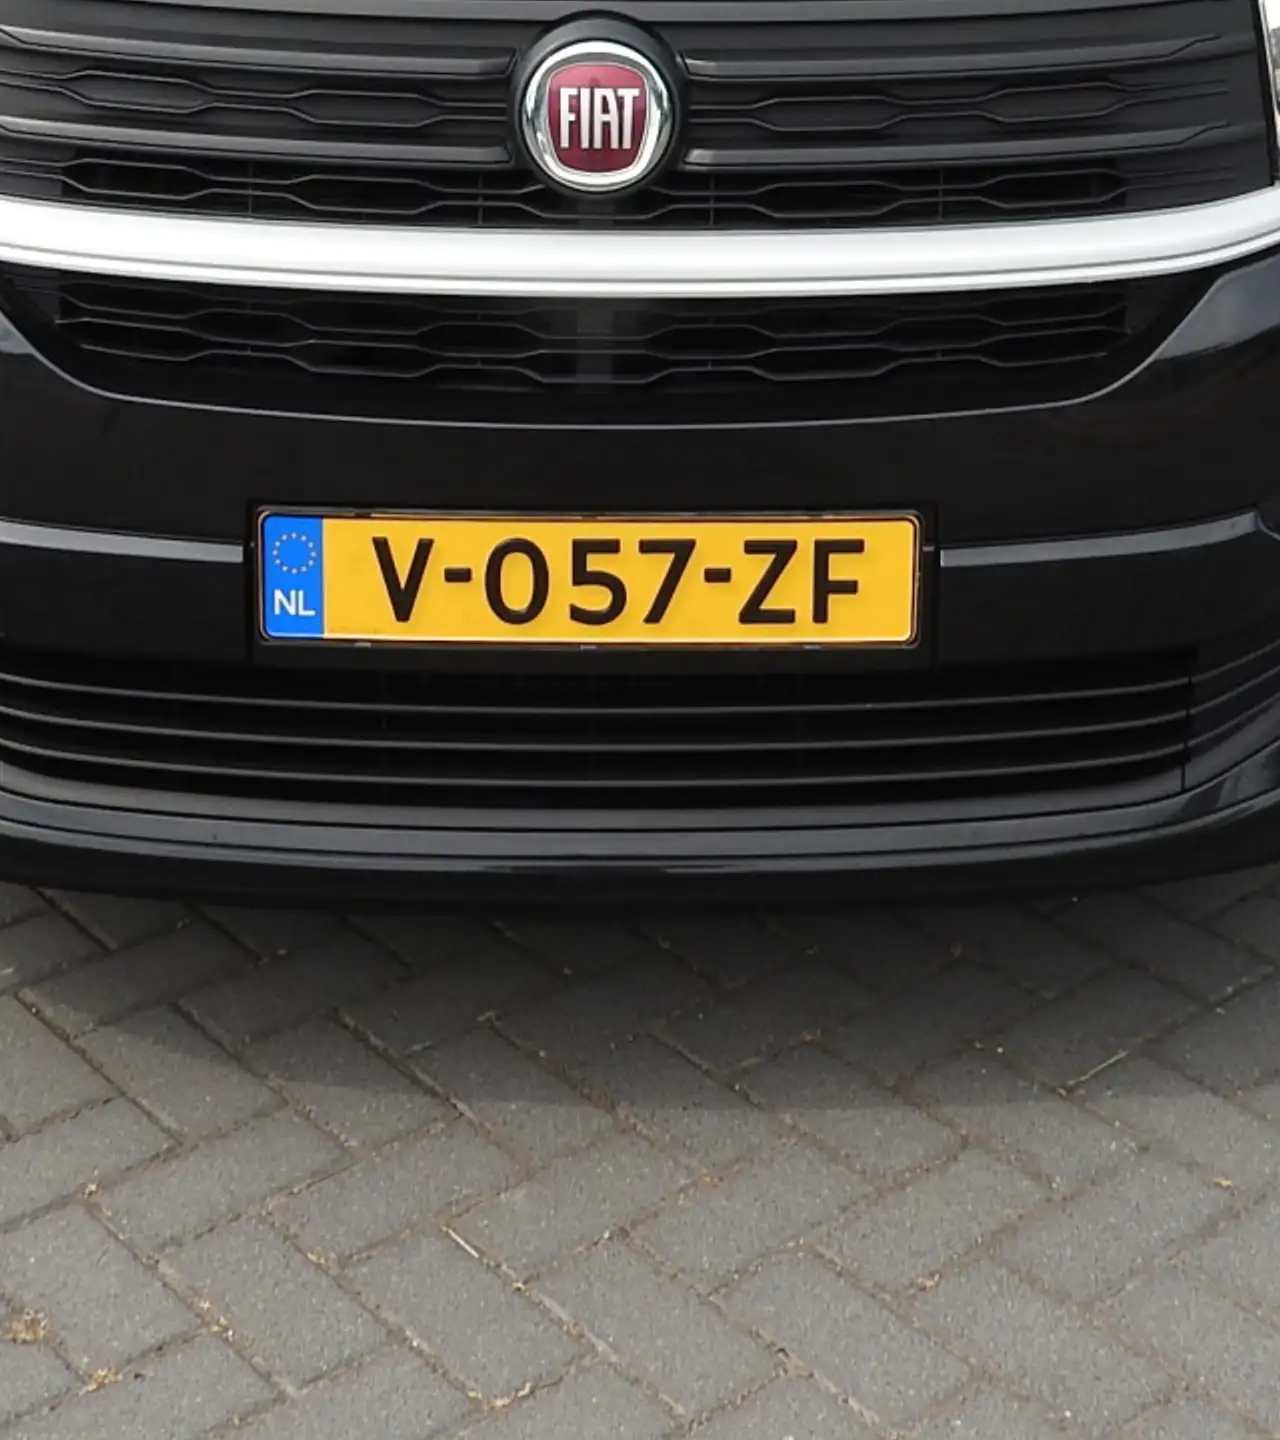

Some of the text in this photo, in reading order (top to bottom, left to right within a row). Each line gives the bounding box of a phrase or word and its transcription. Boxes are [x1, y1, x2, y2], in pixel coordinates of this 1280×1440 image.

[559, 86, 641, 150] FIAT
[273, 589, 316, 617] NL
[371, 535, 866, 626] V-057-ZF
